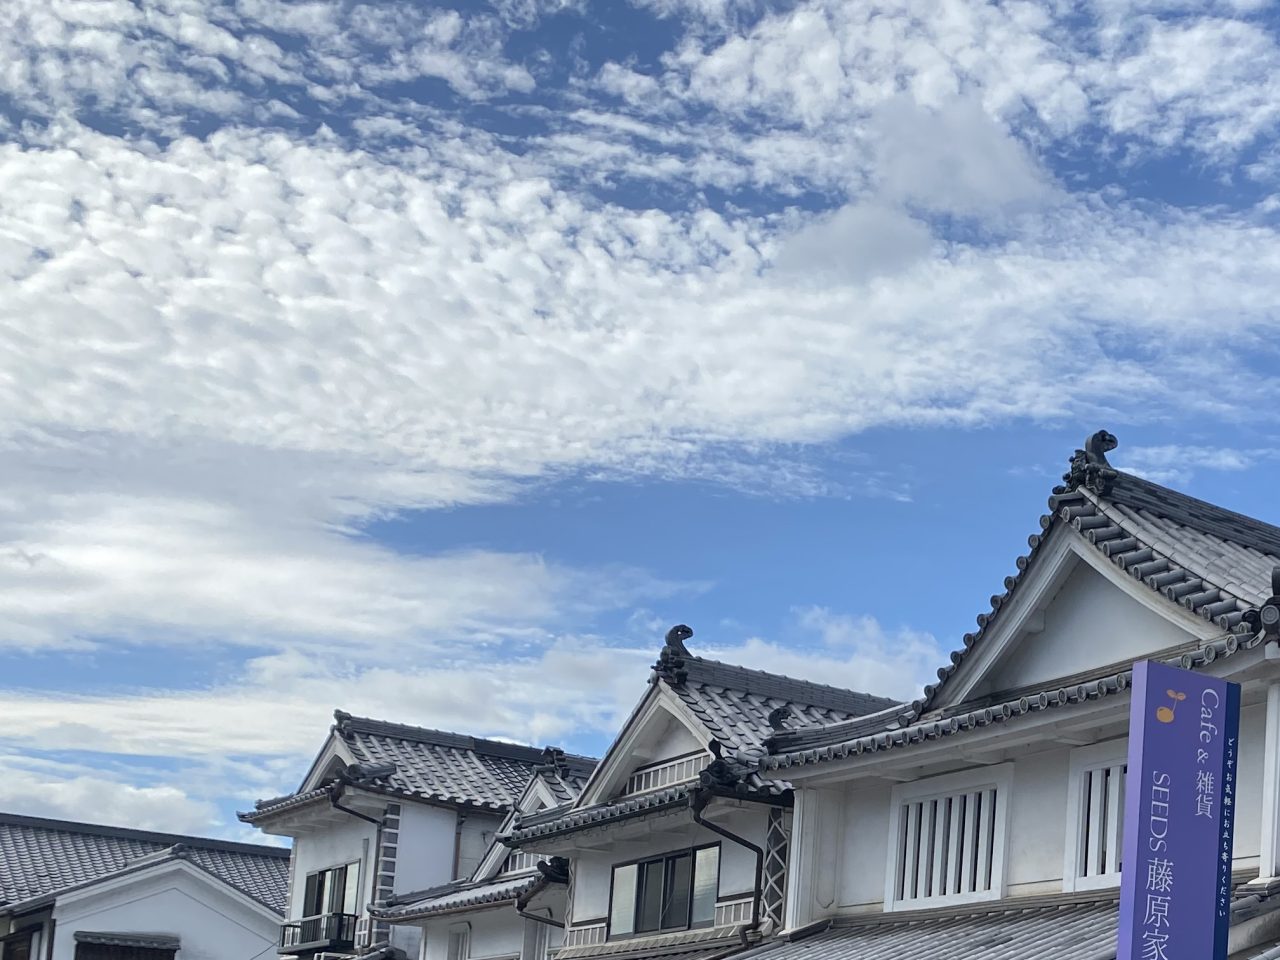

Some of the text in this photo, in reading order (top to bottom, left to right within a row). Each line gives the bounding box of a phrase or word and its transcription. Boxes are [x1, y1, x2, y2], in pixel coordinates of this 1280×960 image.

[1150, 771, 1171, 852] SEEDS
[1195, 688, 1219, 819] Cafe & 雑貨
[1219, 738, 1235, 917] どうぞお気軽にお立ち寄りください
